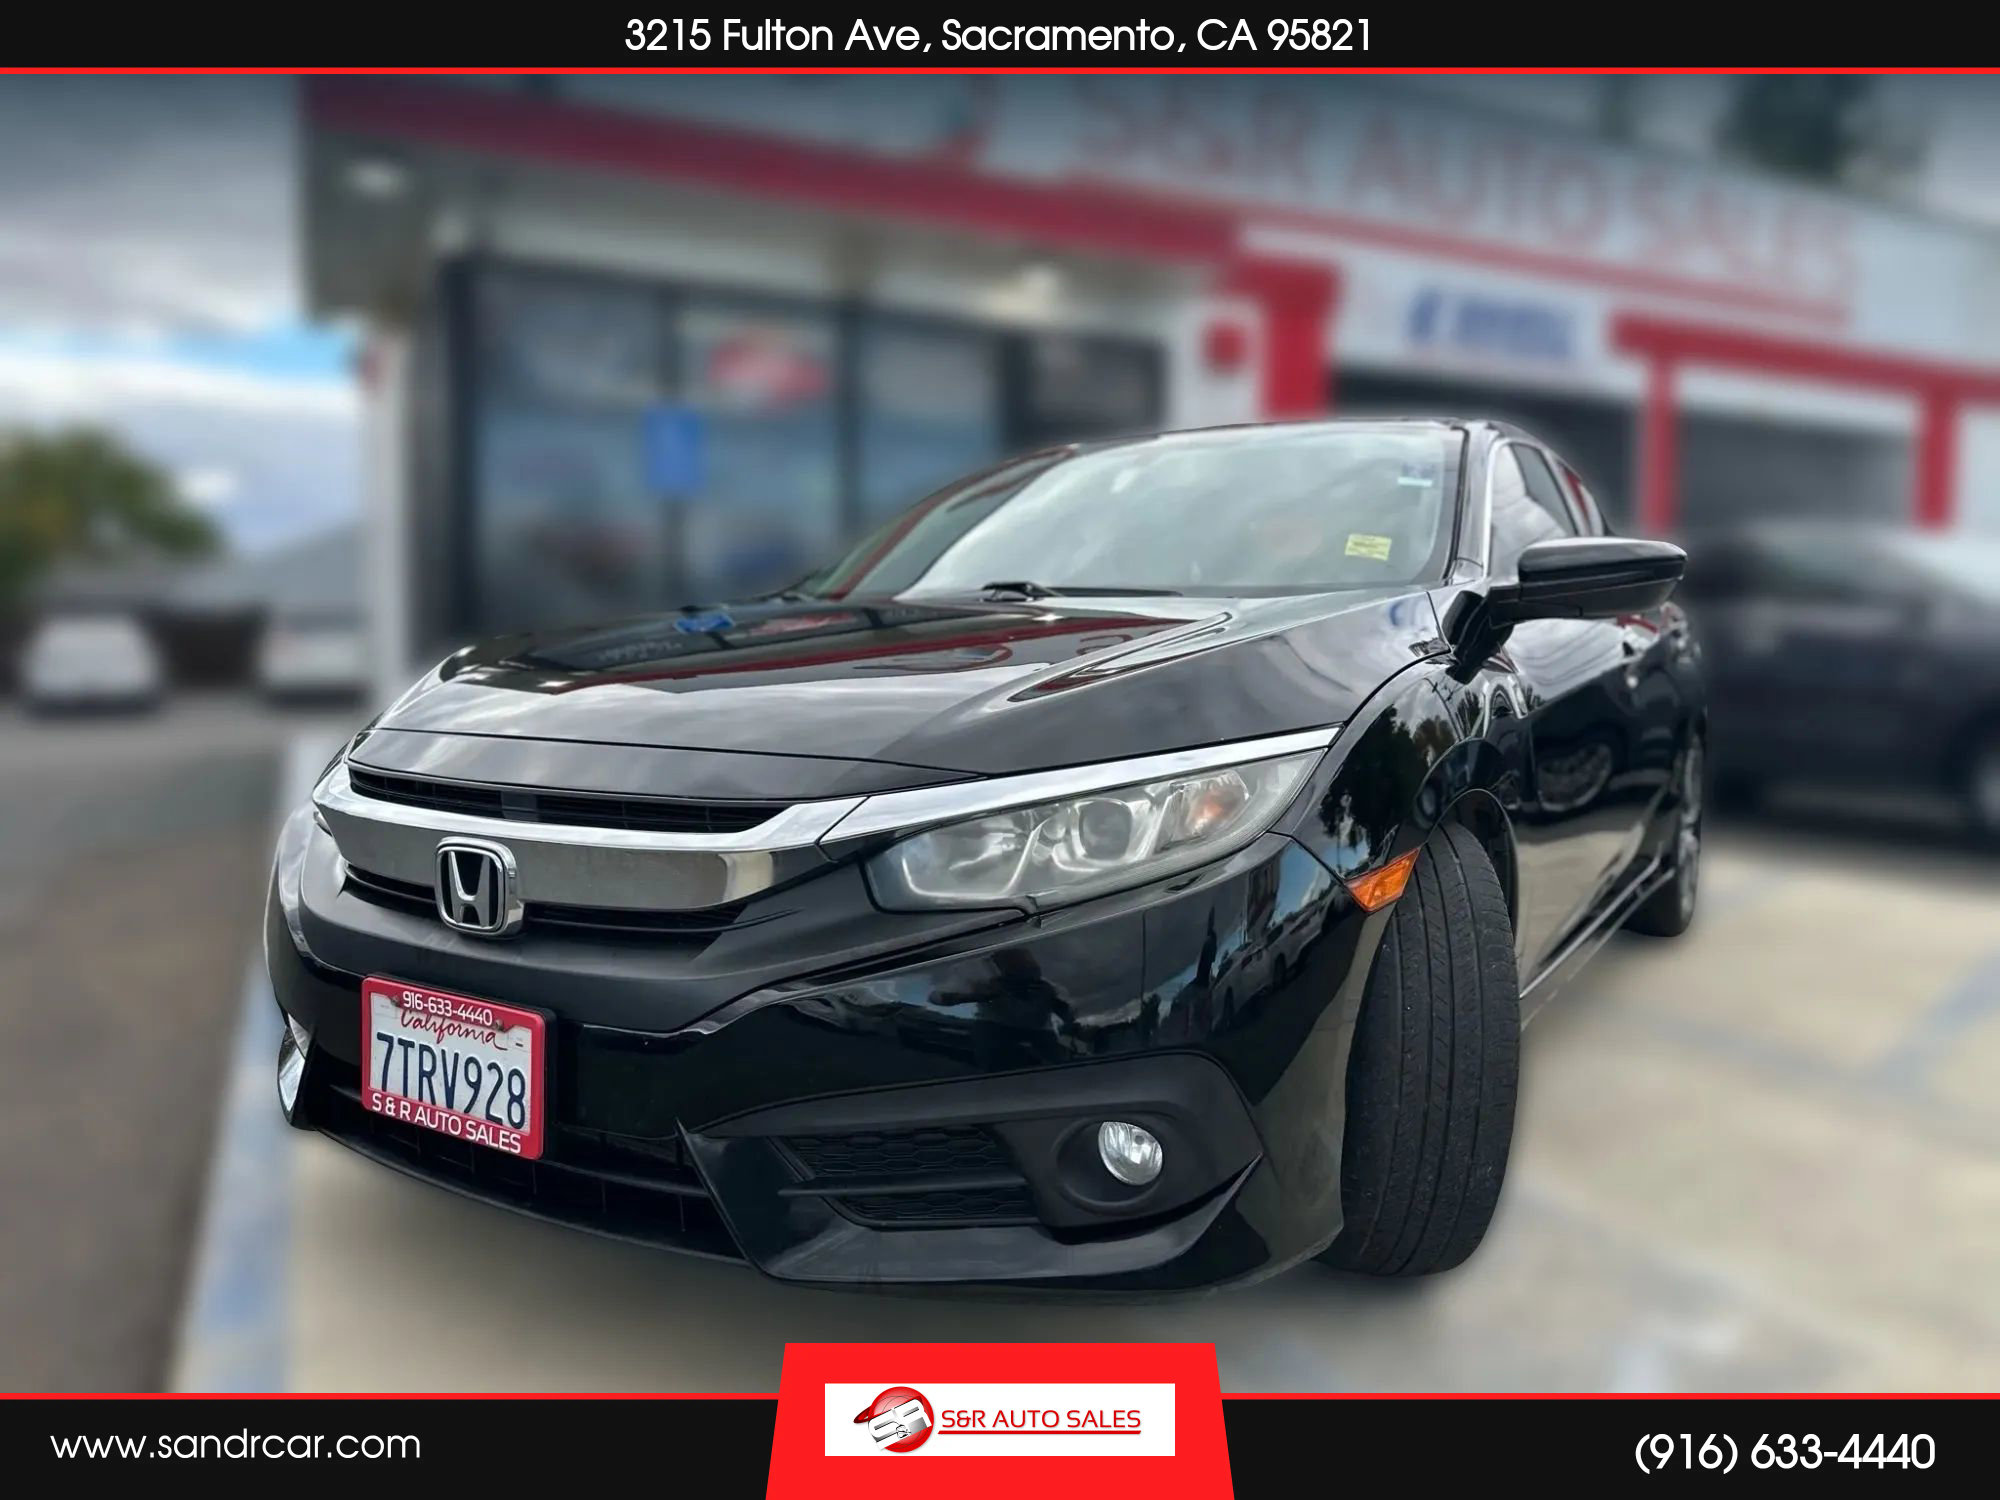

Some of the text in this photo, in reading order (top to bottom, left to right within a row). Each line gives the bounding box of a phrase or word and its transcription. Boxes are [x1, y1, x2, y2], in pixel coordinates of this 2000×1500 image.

[401, 1010, 508, 1051] California
[403, 991, 494, 1027] 916-633-4440
[376, 1032, 526, 1130] 7TRV928
[372, 1093, 522, 1154] S & R AUTO SALES
